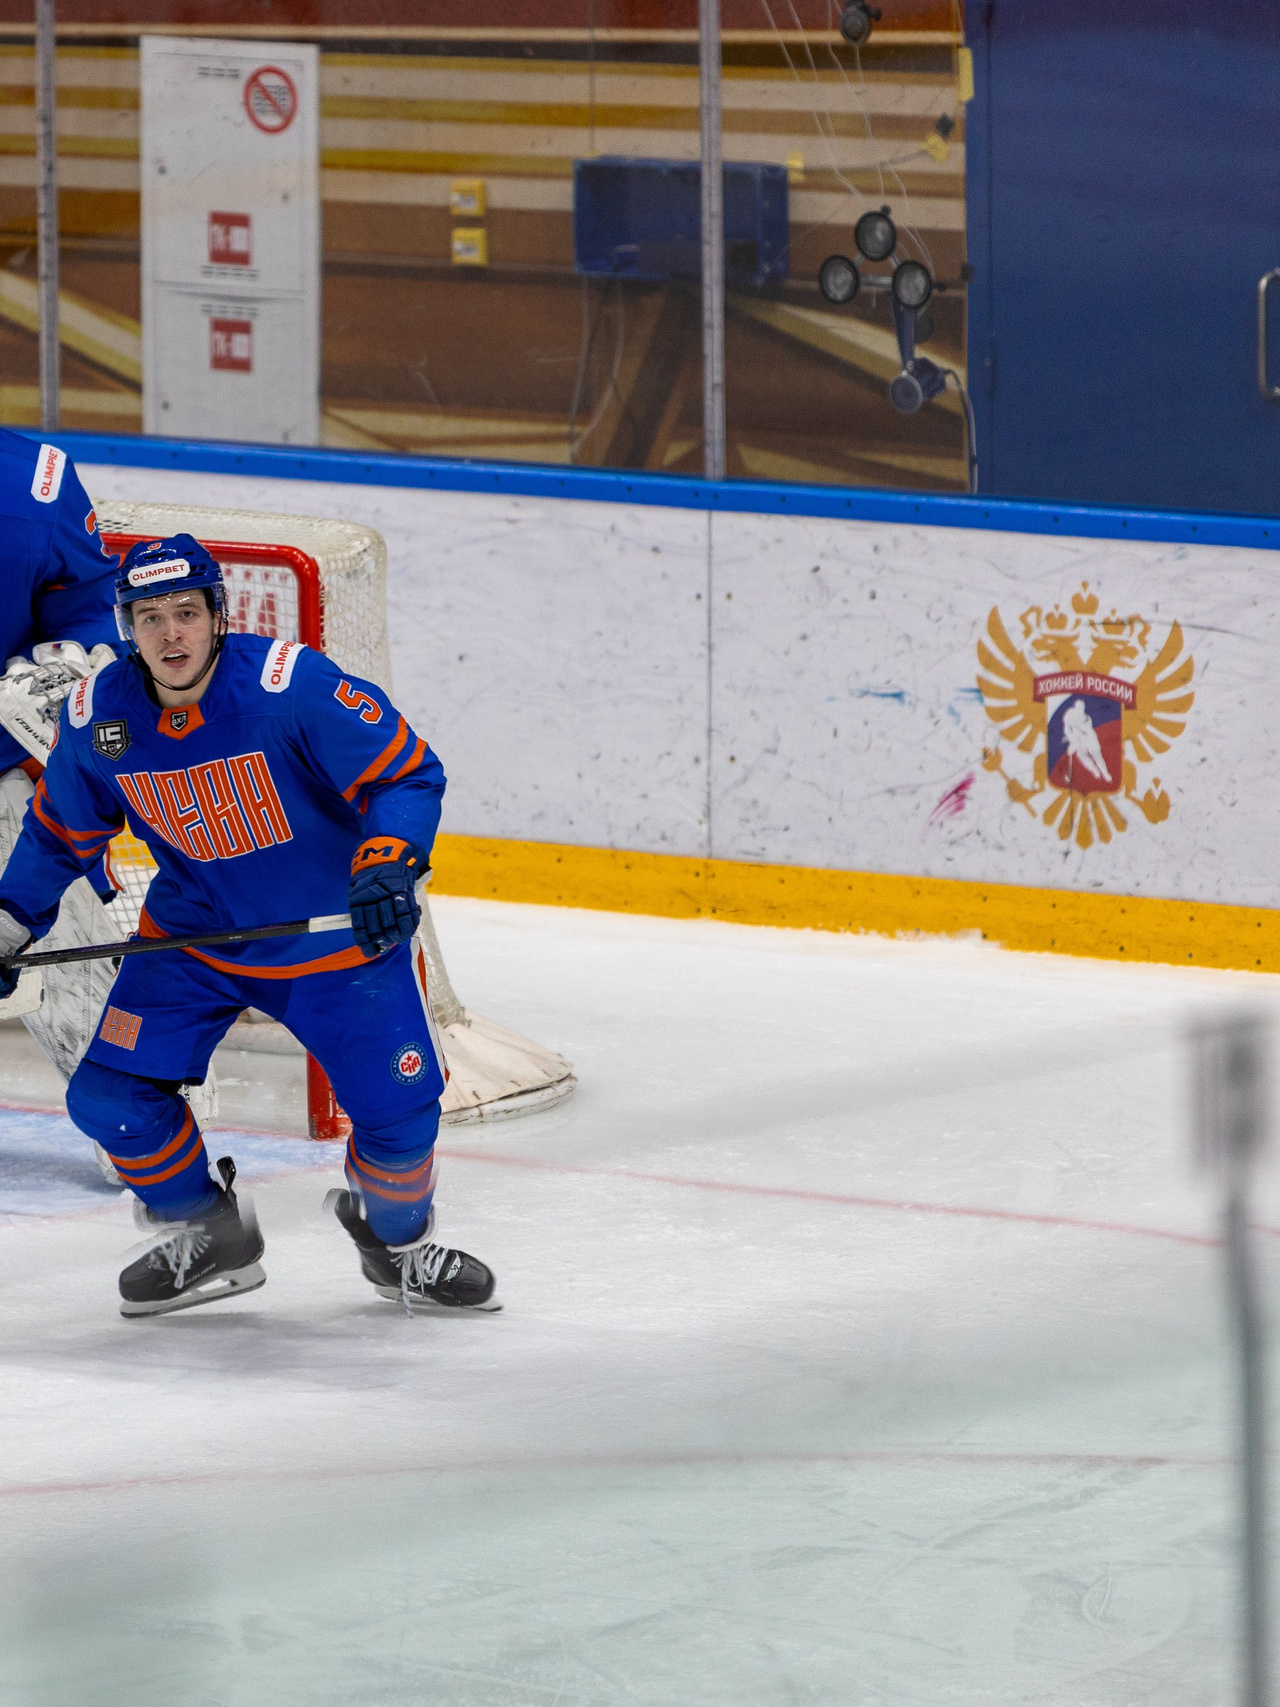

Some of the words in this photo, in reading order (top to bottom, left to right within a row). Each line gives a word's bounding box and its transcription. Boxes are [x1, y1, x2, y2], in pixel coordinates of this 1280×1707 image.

[131, 564, 185, 581] OLIMPBET
[334, 678, 383, 724] 5
[1038, 674, 1083, 695] ХОККЕЙ
[1087, 677, 1133, 702] РОССИИ
